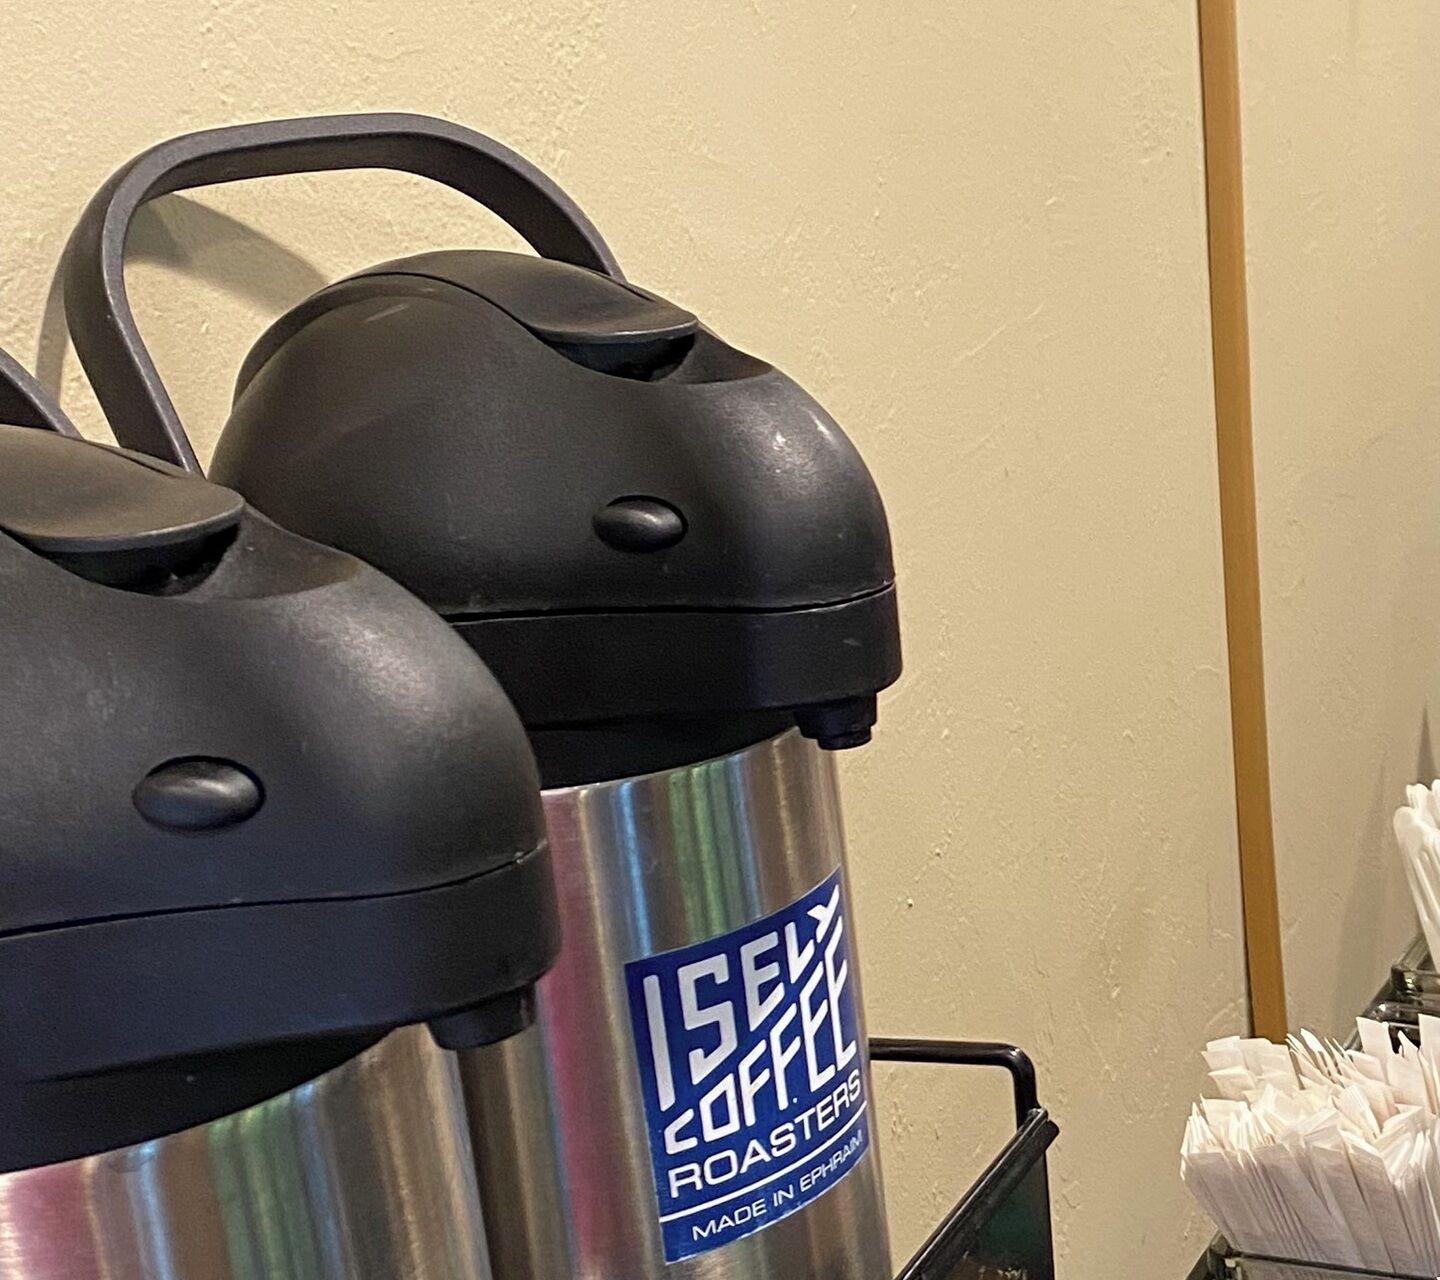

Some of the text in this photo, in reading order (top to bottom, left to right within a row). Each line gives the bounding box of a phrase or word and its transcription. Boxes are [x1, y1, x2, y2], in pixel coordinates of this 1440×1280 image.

[642, 883, 841, 1112] ISELY
[663, 914, 857, 1155] COFFEE
[667, 1068, 863, 1200] ROASTERS
[691, 1129, 864, 1242] MADE IN EPHRAIM
